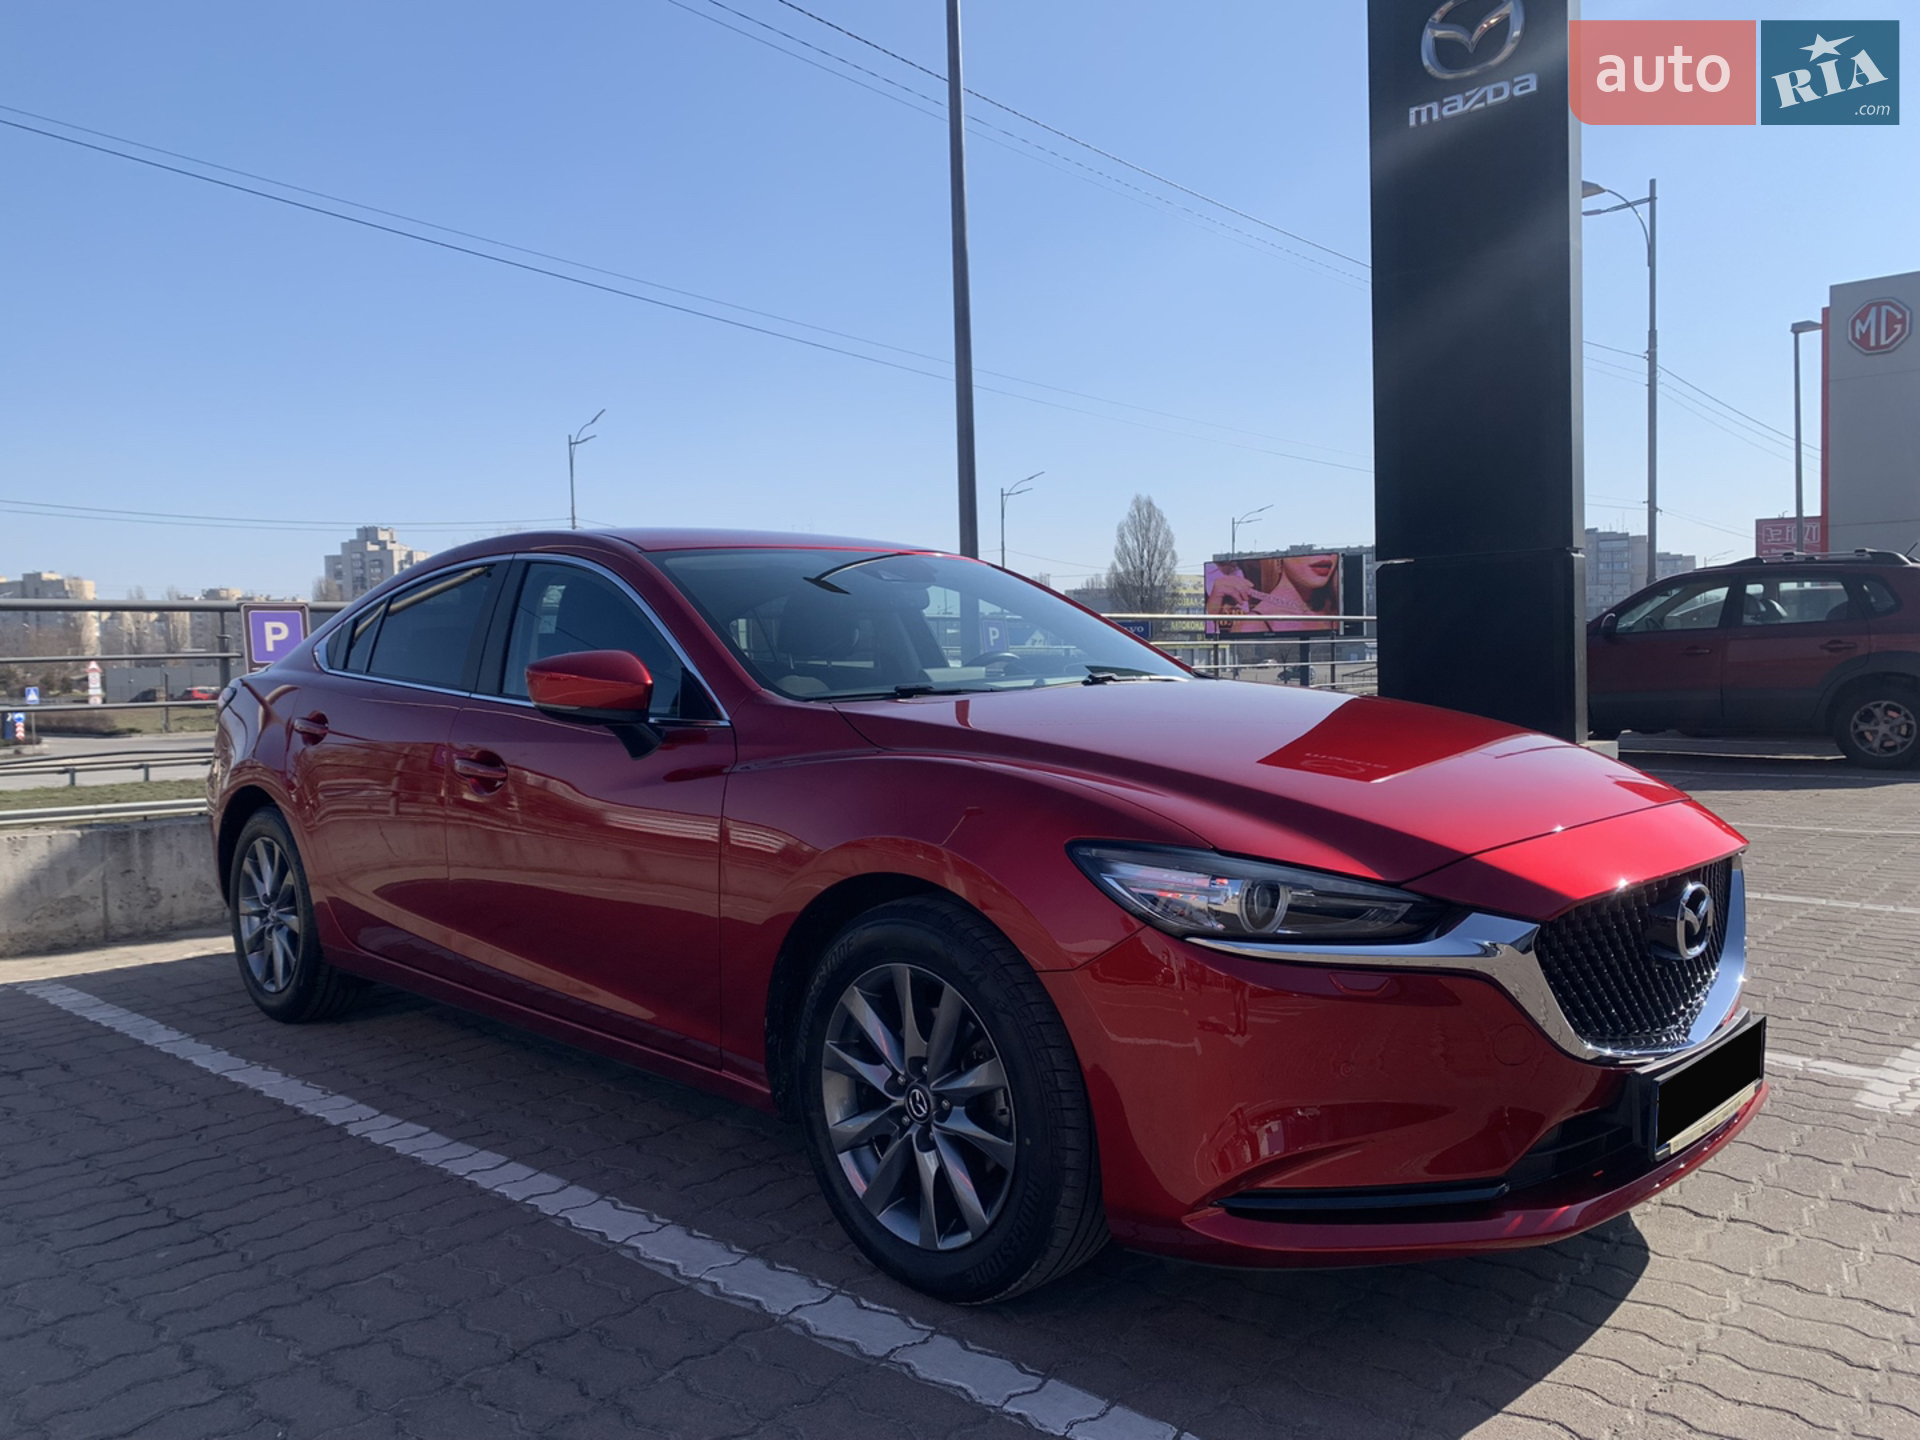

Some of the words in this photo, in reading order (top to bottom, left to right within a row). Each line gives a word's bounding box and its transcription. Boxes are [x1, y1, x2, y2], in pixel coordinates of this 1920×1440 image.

[1408, 72, 1538, 129] mazda
[1855, 305, 1903, 347] MG
[264, 621, 289, 652] P
[988, 627, 999, 646] P
